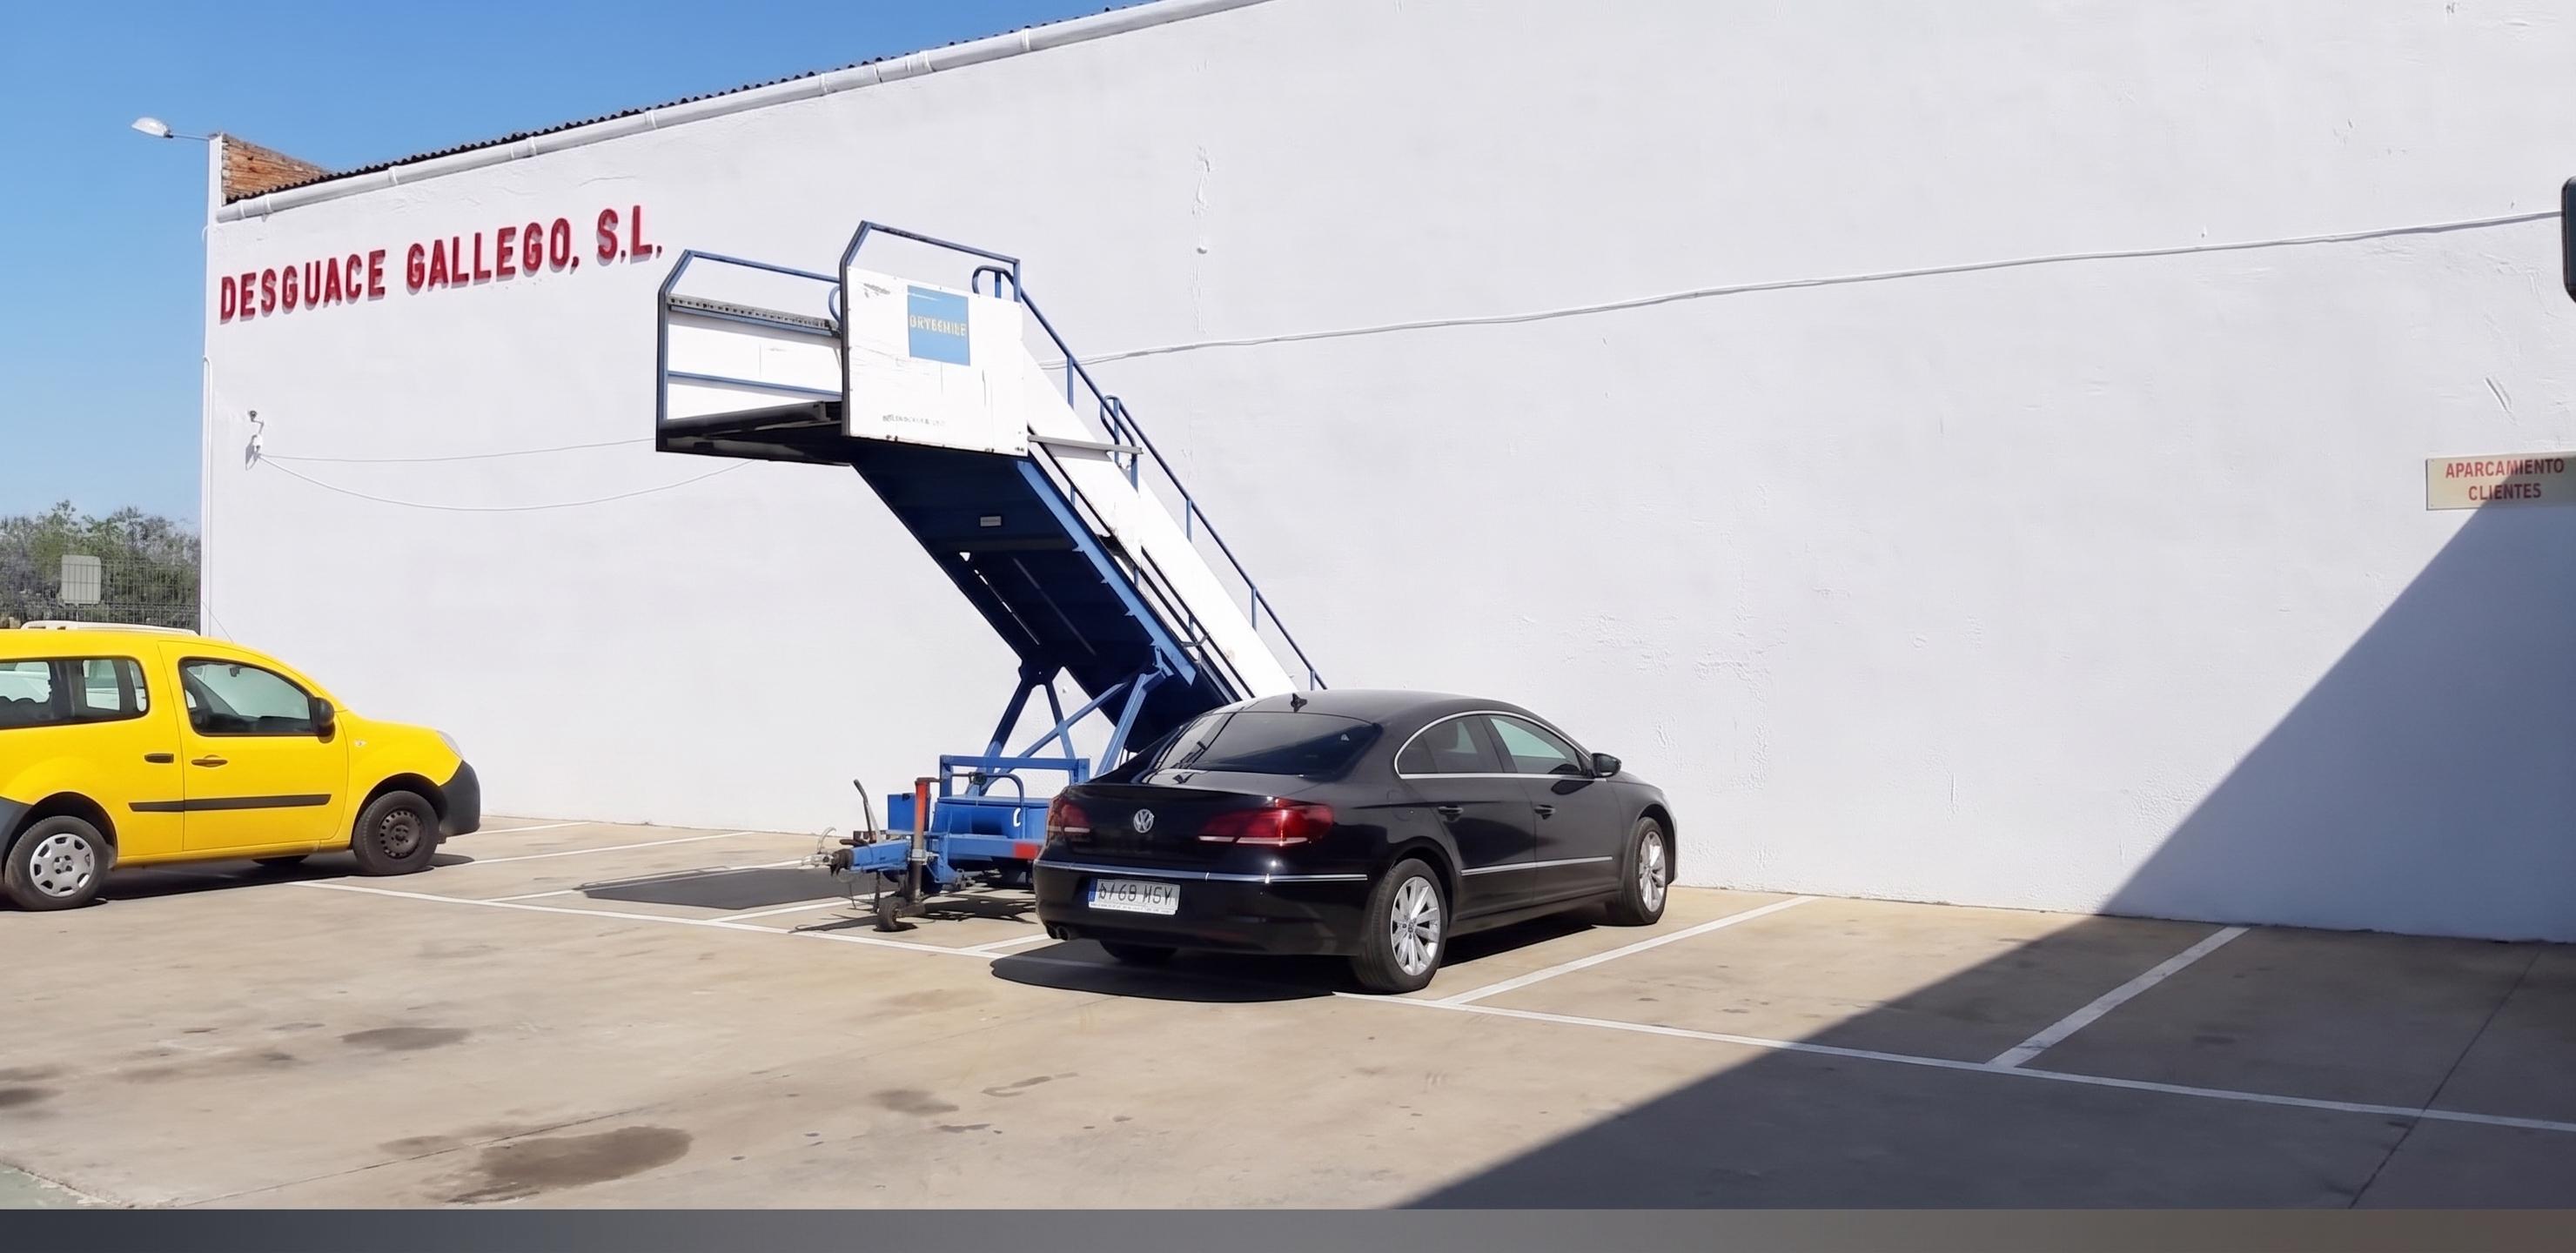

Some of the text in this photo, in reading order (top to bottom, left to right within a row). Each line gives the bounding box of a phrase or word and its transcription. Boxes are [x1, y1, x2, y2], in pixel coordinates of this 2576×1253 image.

[220, 205, 662, 322] DESGUACE GALLEGO, S.L.
[2445, 458, 2565, 479] APARCAMIENTO
[2468, 483, 2541, 501] CLIENTES
